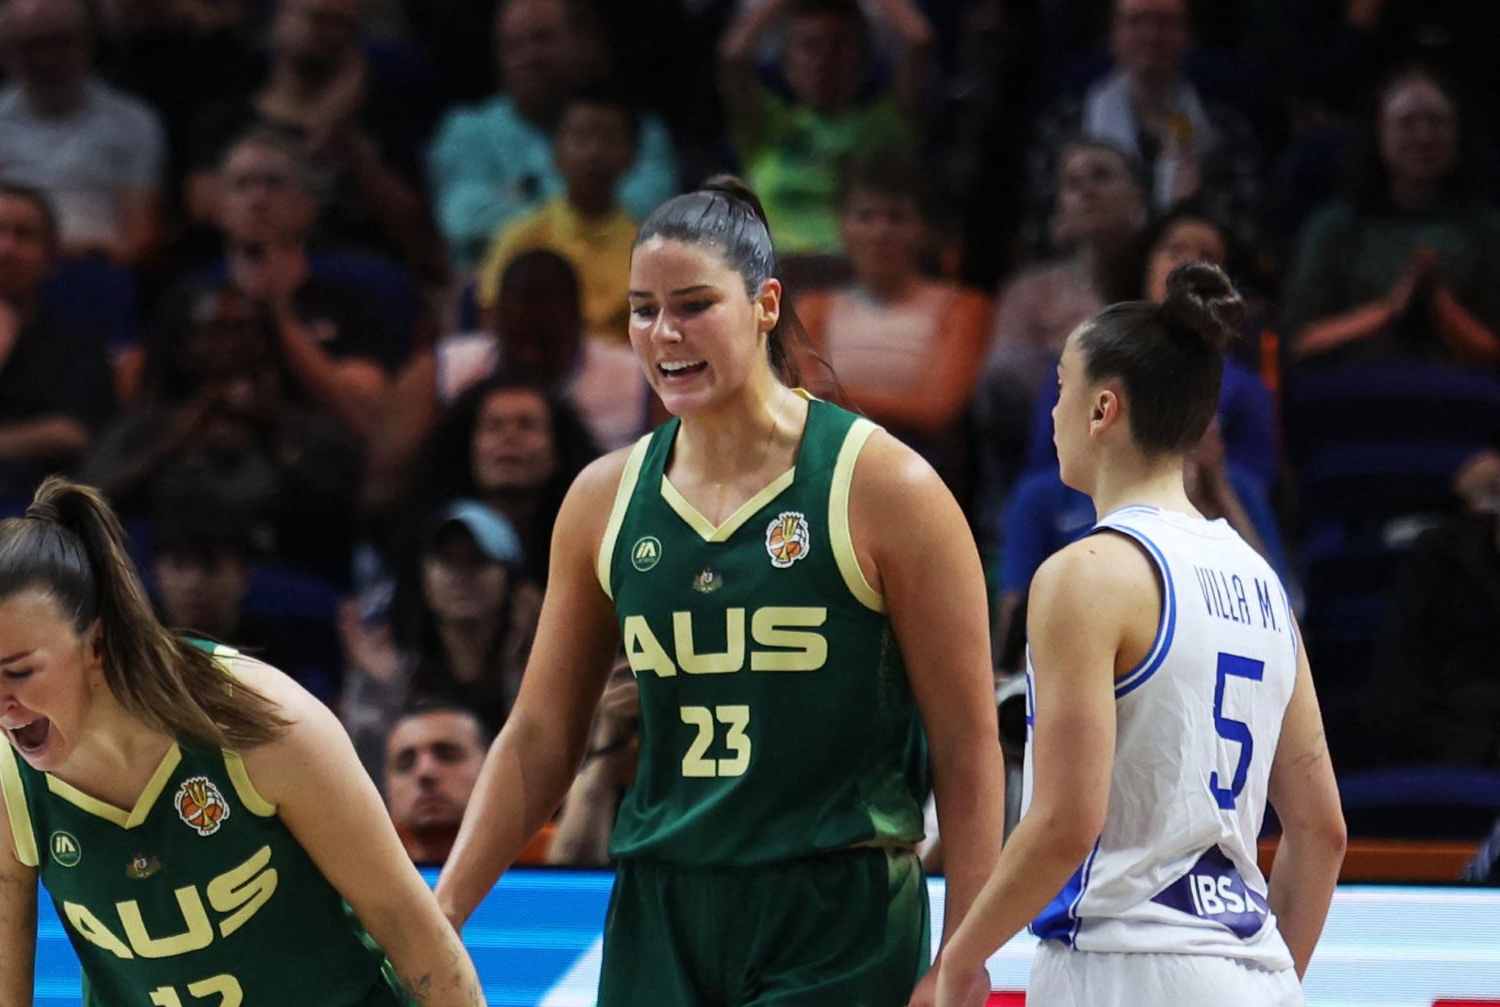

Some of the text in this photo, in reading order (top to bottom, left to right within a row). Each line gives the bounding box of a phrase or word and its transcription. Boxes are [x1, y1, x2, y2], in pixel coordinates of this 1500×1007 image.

[1193, 564, 1281, 633] VILLA M.
[623, 606, 829, 679] AUS
[679, 704, 752, 778] 23
[1209, 651, 1265, 810] 5
[63, 844, 279, 960] AUS
